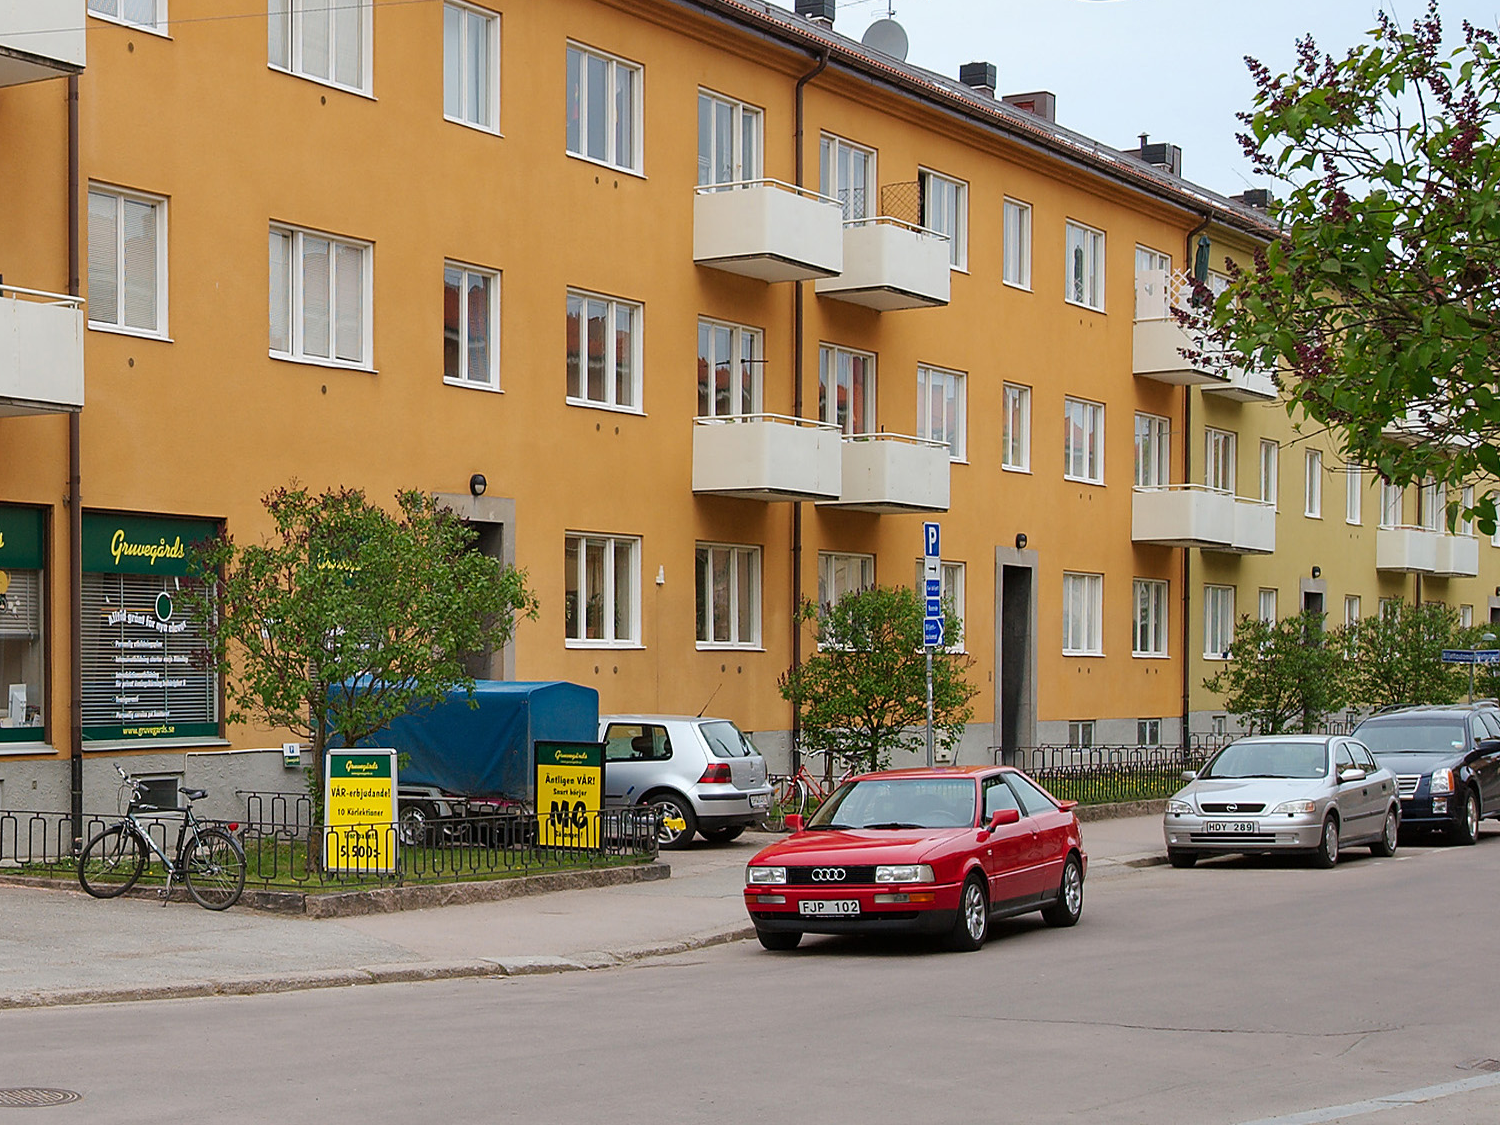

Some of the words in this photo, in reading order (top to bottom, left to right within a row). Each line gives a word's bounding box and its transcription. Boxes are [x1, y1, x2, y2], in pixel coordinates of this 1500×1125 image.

[111, 529, 185, 565] Gruvegårds
[928, 526, 938, 555] P
[545, 773, 575, 787] Äntligen
[576, 773, 596, 785] VÅR!
[331, 785, 391, 800] VÅR-erbjudande!
[550, 800, 588, 829] MC
[1209, 823, 1227, 832] HDY
[1233, 823, 1253, 832] 289
[802, 901, 825, 913] FJP
[834, 901, 859, 913] 102
